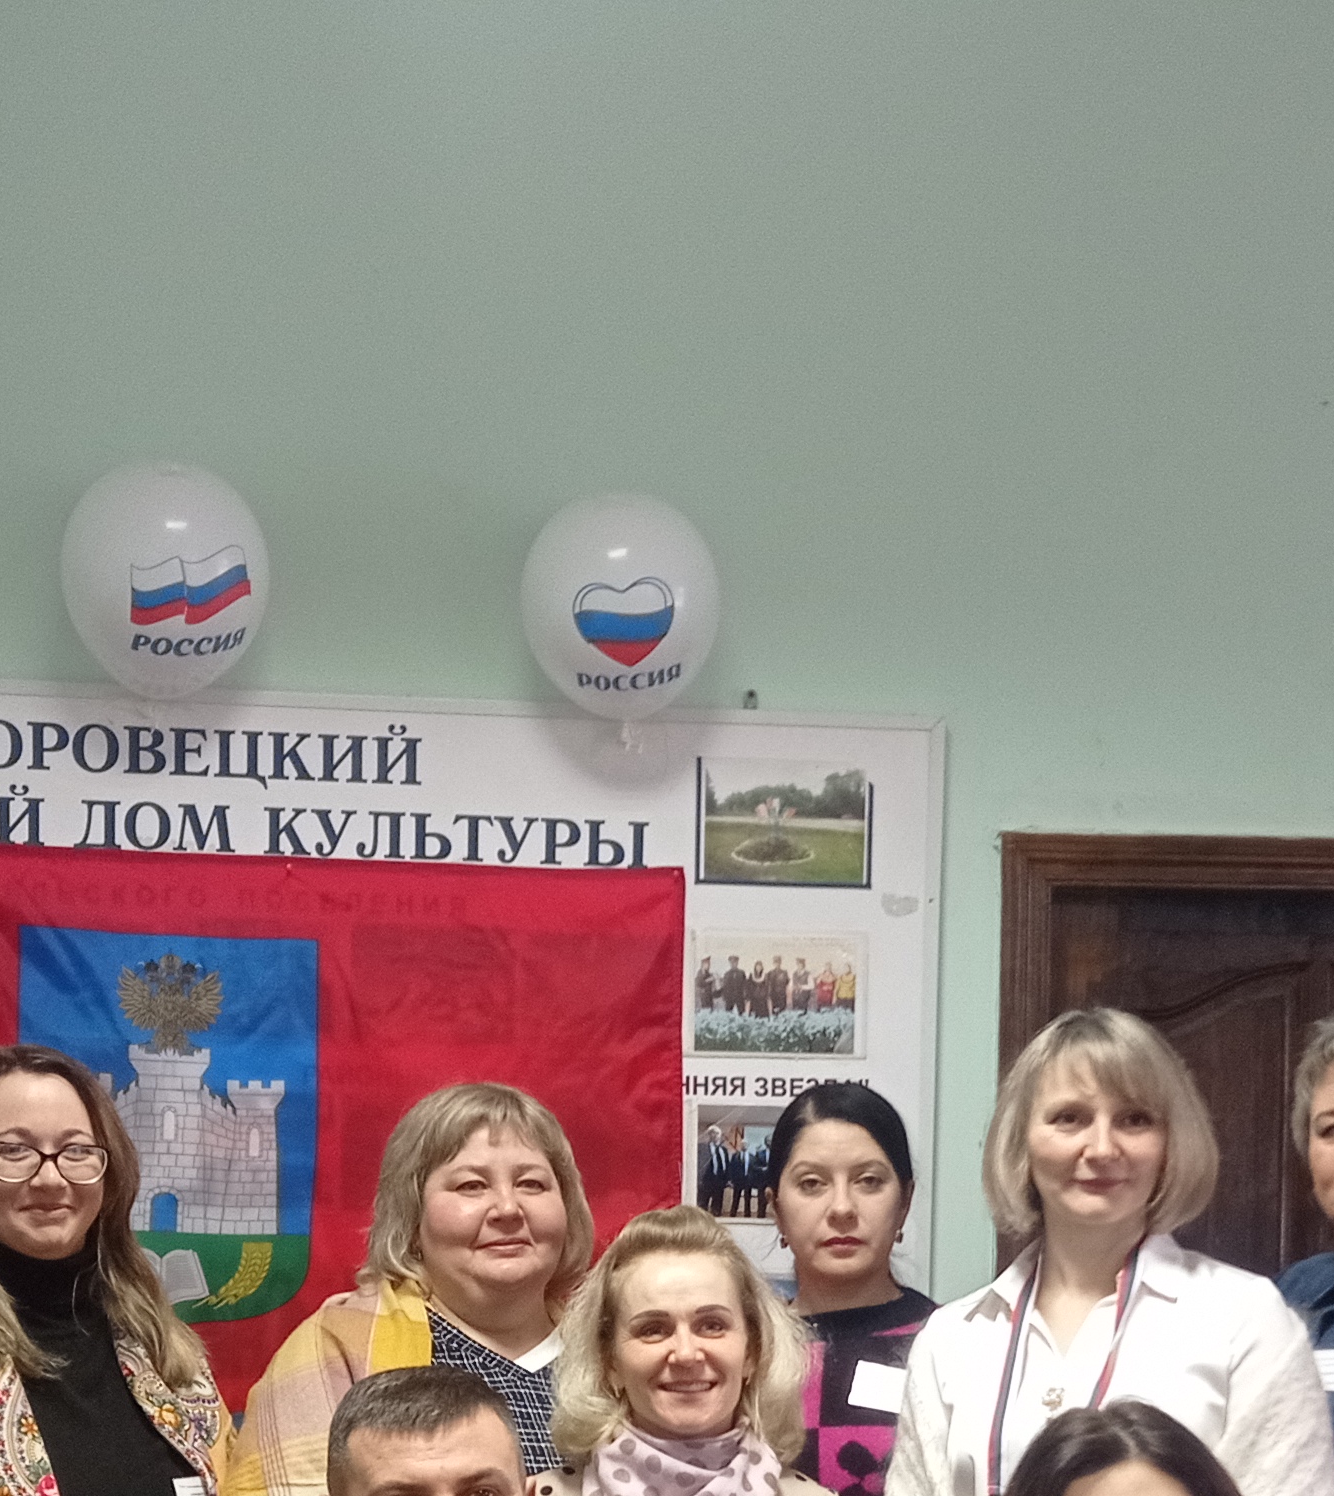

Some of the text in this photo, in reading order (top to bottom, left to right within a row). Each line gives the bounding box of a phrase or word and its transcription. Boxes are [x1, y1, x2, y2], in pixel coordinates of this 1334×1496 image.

[131, 626, 246, 657] РОССИЯ
[576, 662, 681, 691] РОССИЯ
[74, 800, 235, 854] ДОМ
[264, 807, 649, 869] КУЛЬТУРЫ
